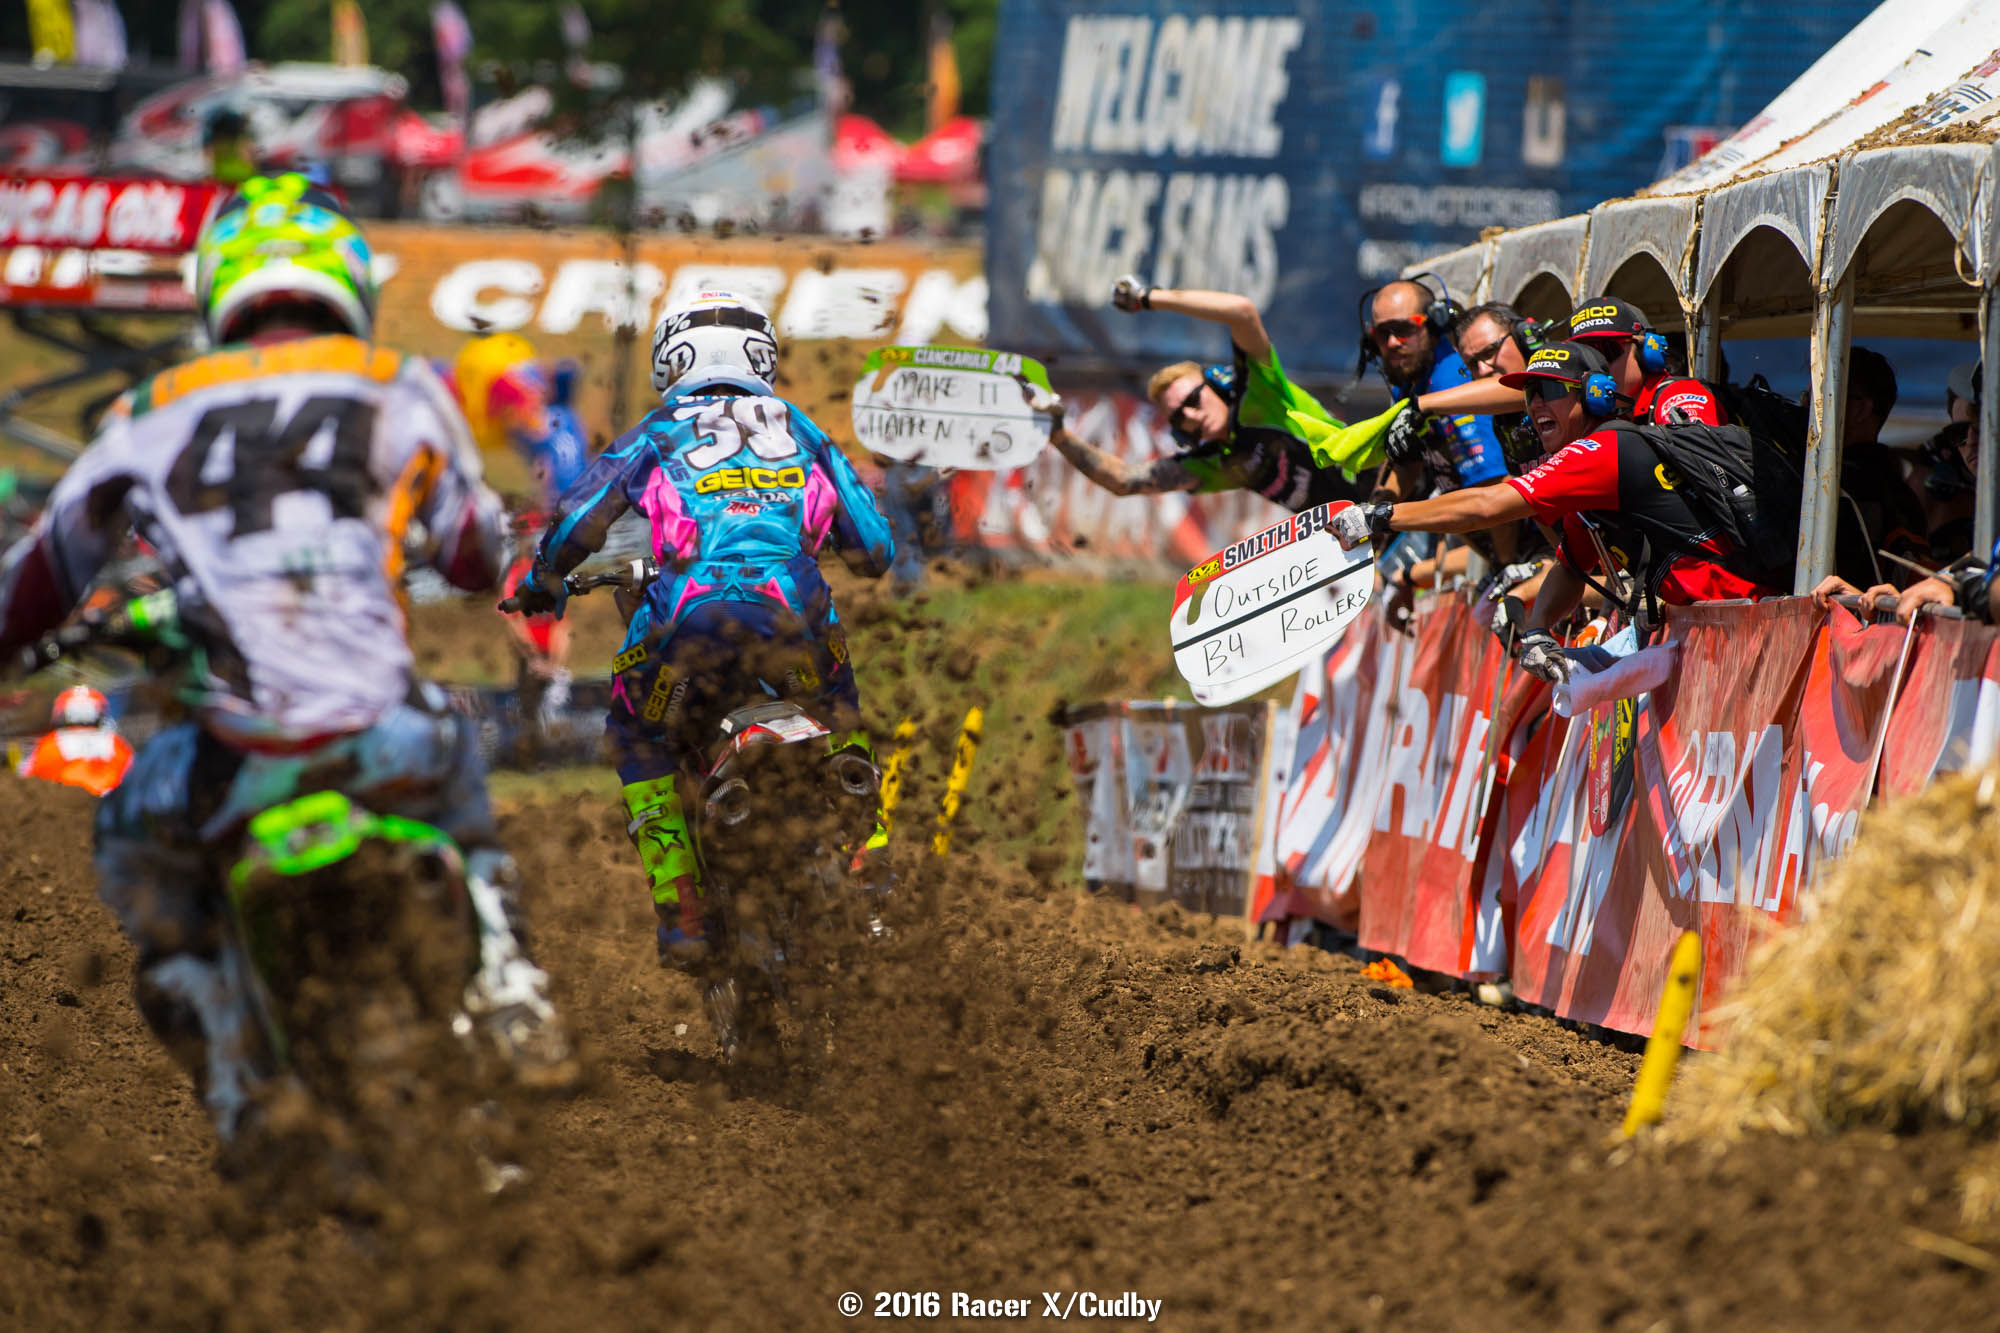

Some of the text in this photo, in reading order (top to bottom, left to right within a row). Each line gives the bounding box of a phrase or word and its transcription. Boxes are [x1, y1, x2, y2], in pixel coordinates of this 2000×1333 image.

[1053, 14, 1304, 158] WELCOME
[1570, 305, 1618, 327] GEICO
[1573, 318, 1614, 333] HONDA
[893, 371, 958, 401] MAKE
[672, 395, 798, 471] 39
[868, 412, 953, 441] HAPPEN
[166, 397, 377, 537] 44
[694, 466, 806, 495] GEICO
[1224, 503, 1330, 569] SMITH 39
[1214, 558, 1320, 618] OUTSIDE
[1203, 588, 1367, 676] B4 ROLLERS
